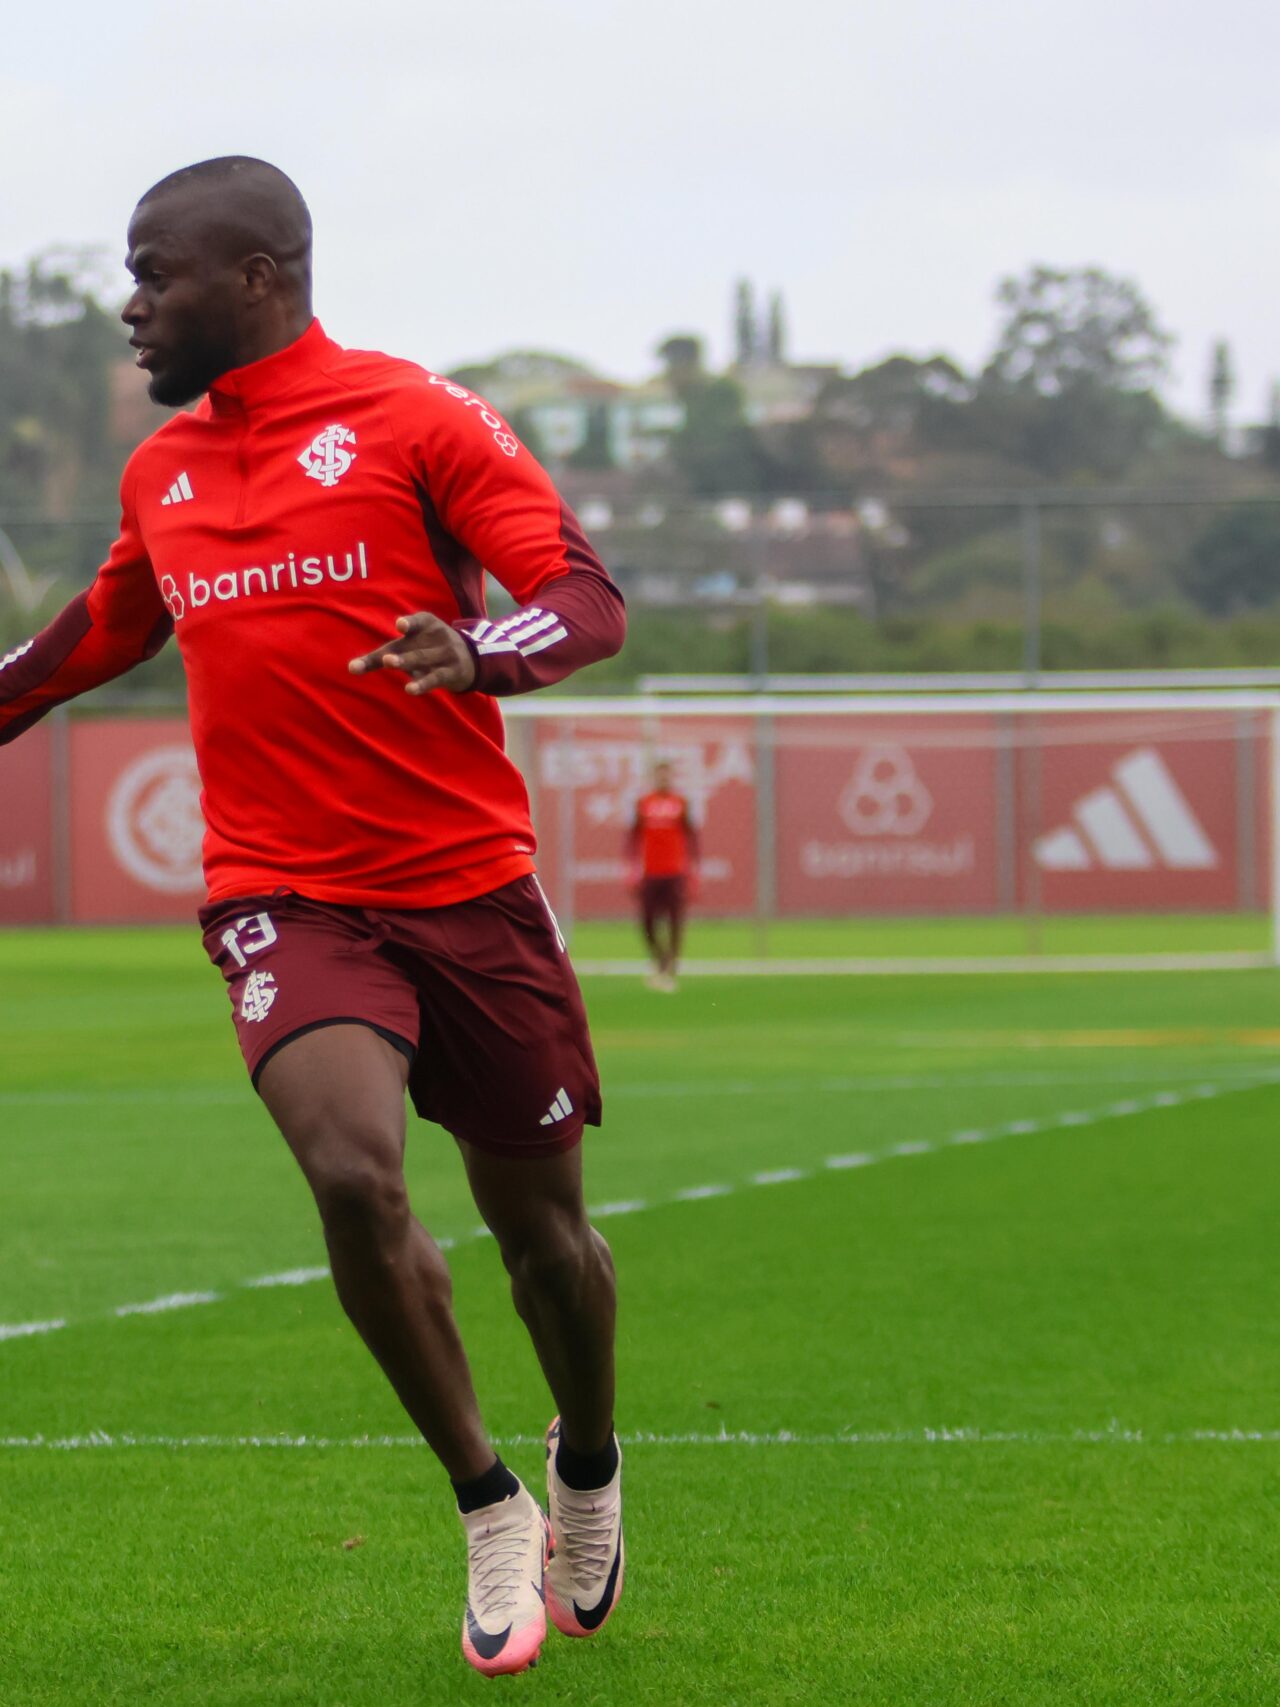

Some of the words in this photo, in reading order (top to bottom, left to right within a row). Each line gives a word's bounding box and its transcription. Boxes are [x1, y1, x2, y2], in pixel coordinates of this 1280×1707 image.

[428, 375, 501, 430] vero
[189, 542, 367, 608] banrisul
[221, 912, 277, 967] 13
